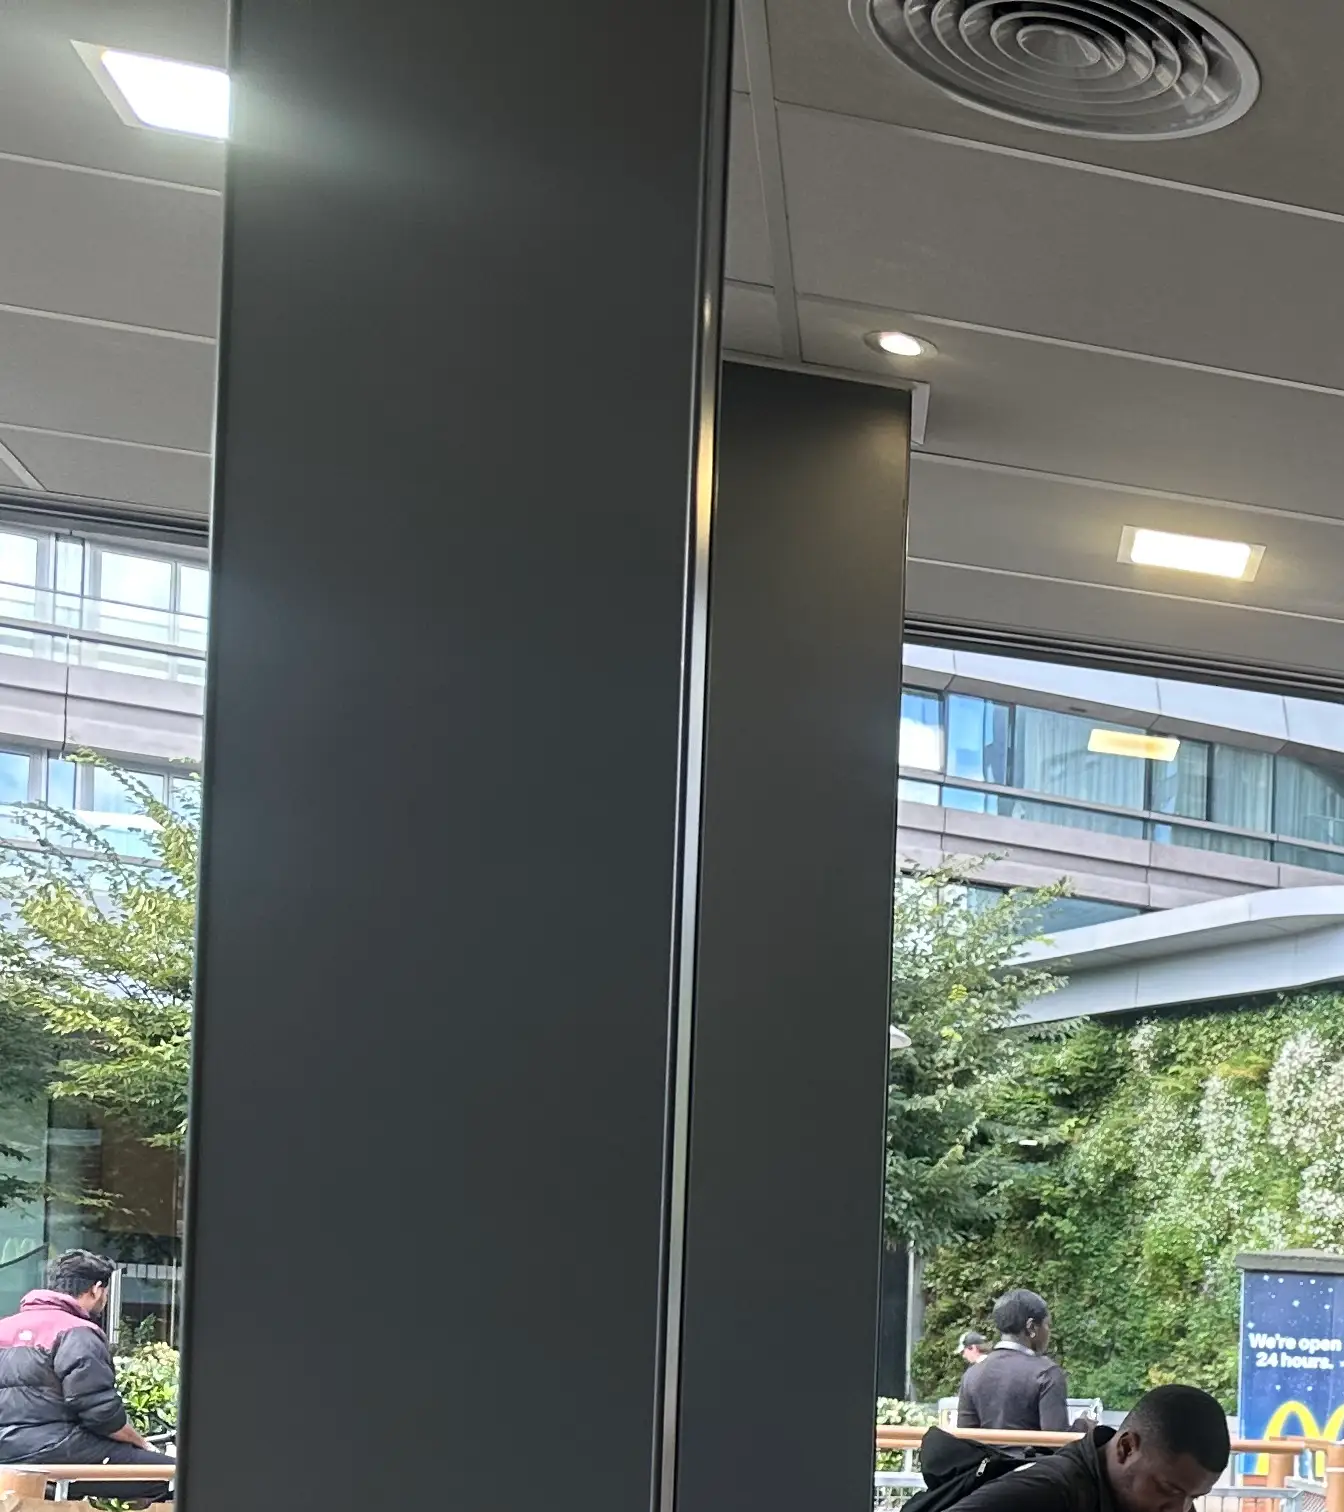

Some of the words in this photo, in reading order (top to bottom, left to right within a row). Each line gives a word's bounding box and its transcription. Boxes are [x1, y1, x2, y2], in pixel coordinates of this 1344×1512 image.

[1249, 1333, 1296, 1349] We're
[1299, 1337, 1342, 1354] open
[1255, 1352, 1279, 1367] 24
[1280, 1352, 1334, 1369] hours.
